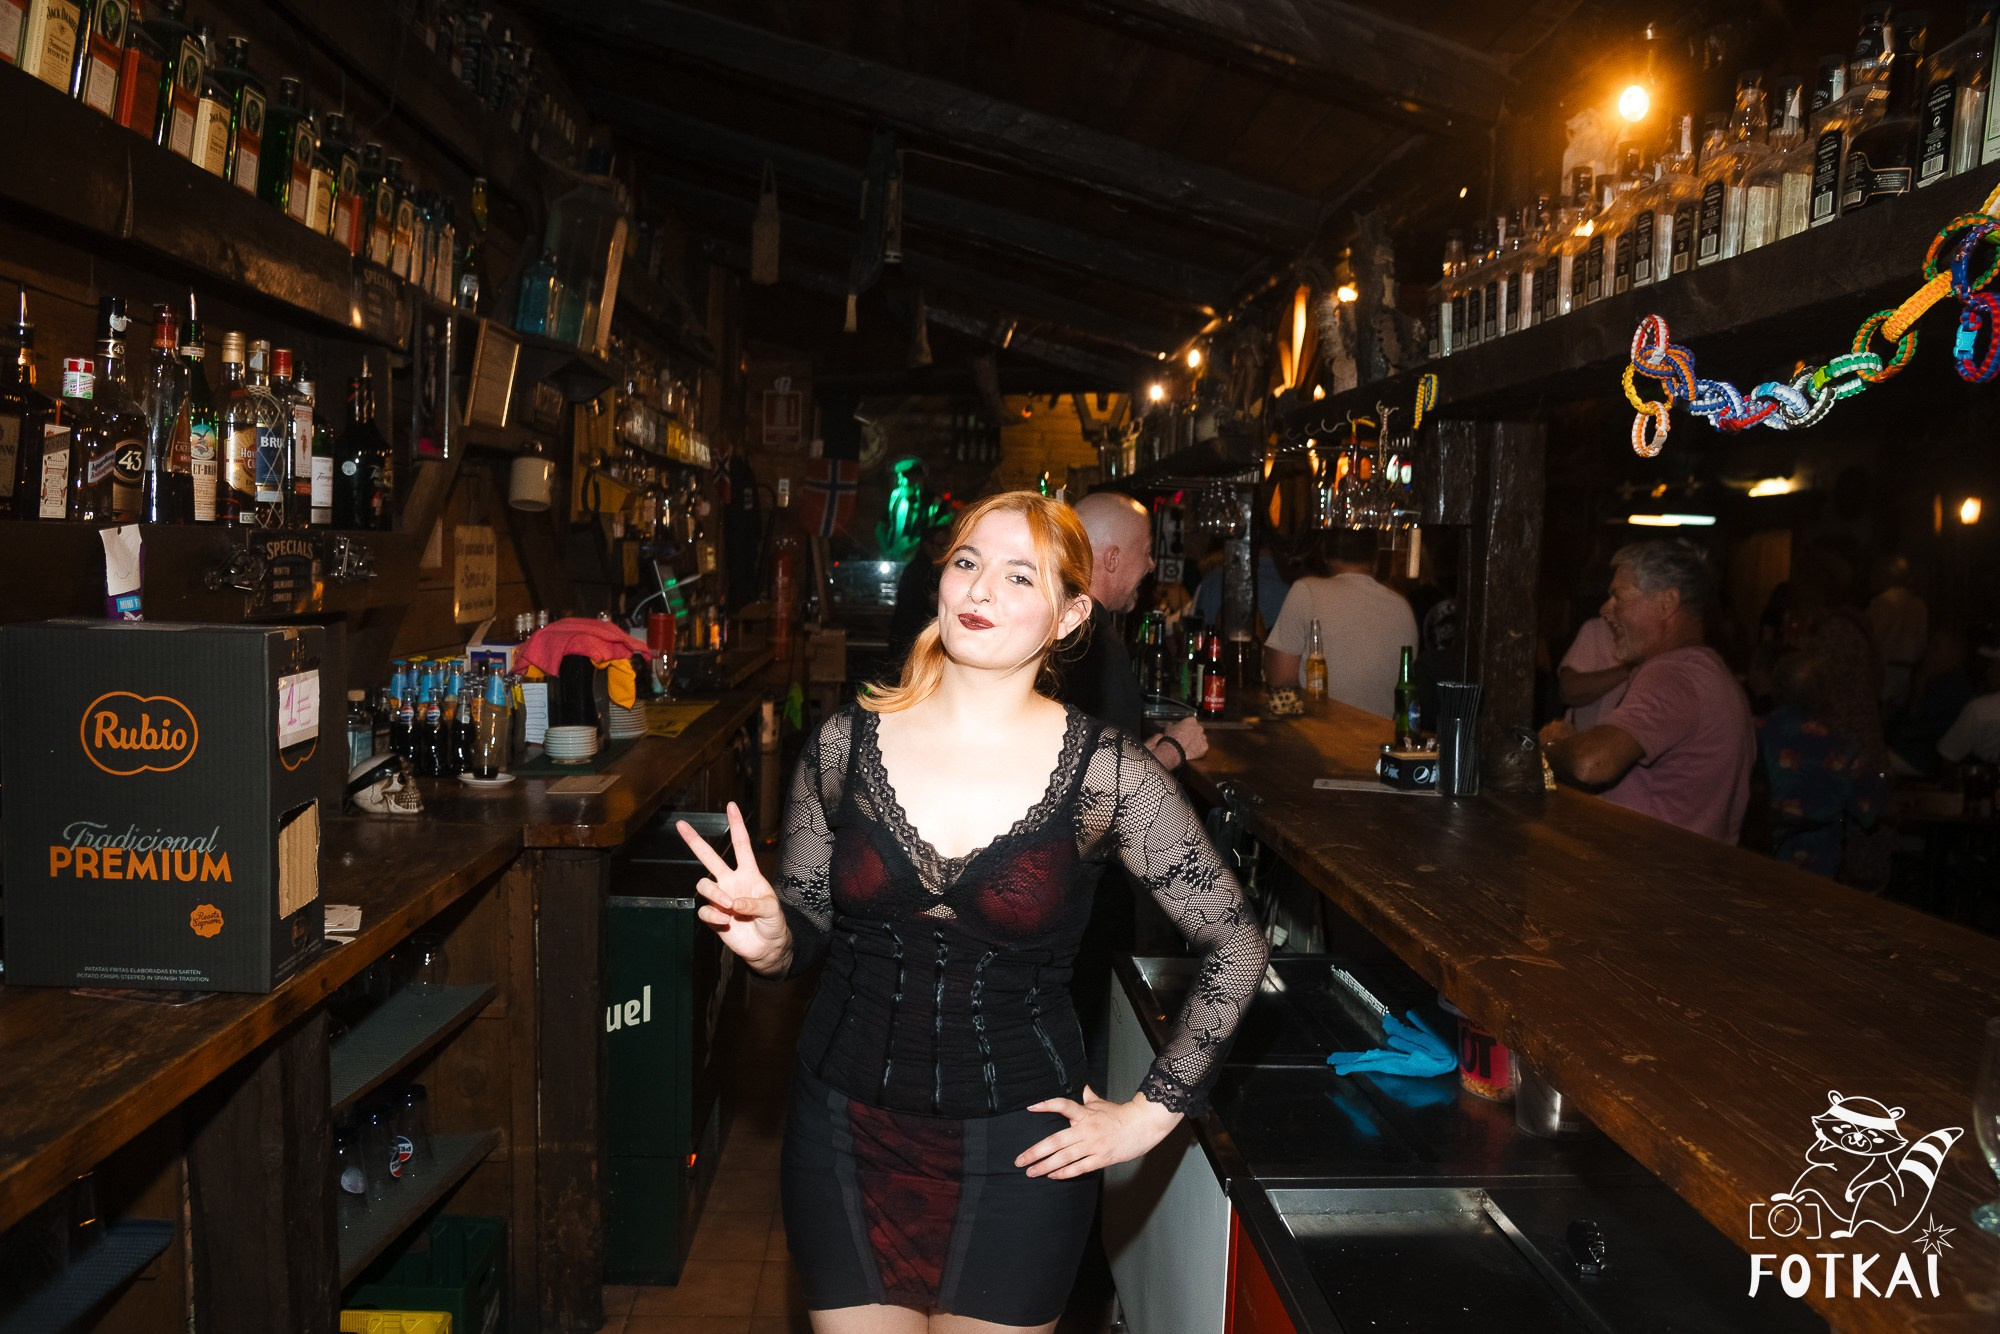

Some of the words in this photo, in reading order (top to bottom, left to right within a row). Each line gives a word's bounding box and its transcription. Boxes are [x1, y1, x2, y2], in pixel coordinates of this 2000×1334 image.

[46, 6, 61, 21] JACK
[48, 48, 70, 64] HONEY
[113, 344, 126, 356] 43
[118, 450, 143, 471] 43
[266, 539, 314, 560] SPECIALS
[94, 710, 187, 751] Rubio
[62, 821, 220, 853] Tradicional
[49, 845, 233, 883] PREMIUM
[130, 967, 169, 975] ELABORADAS
